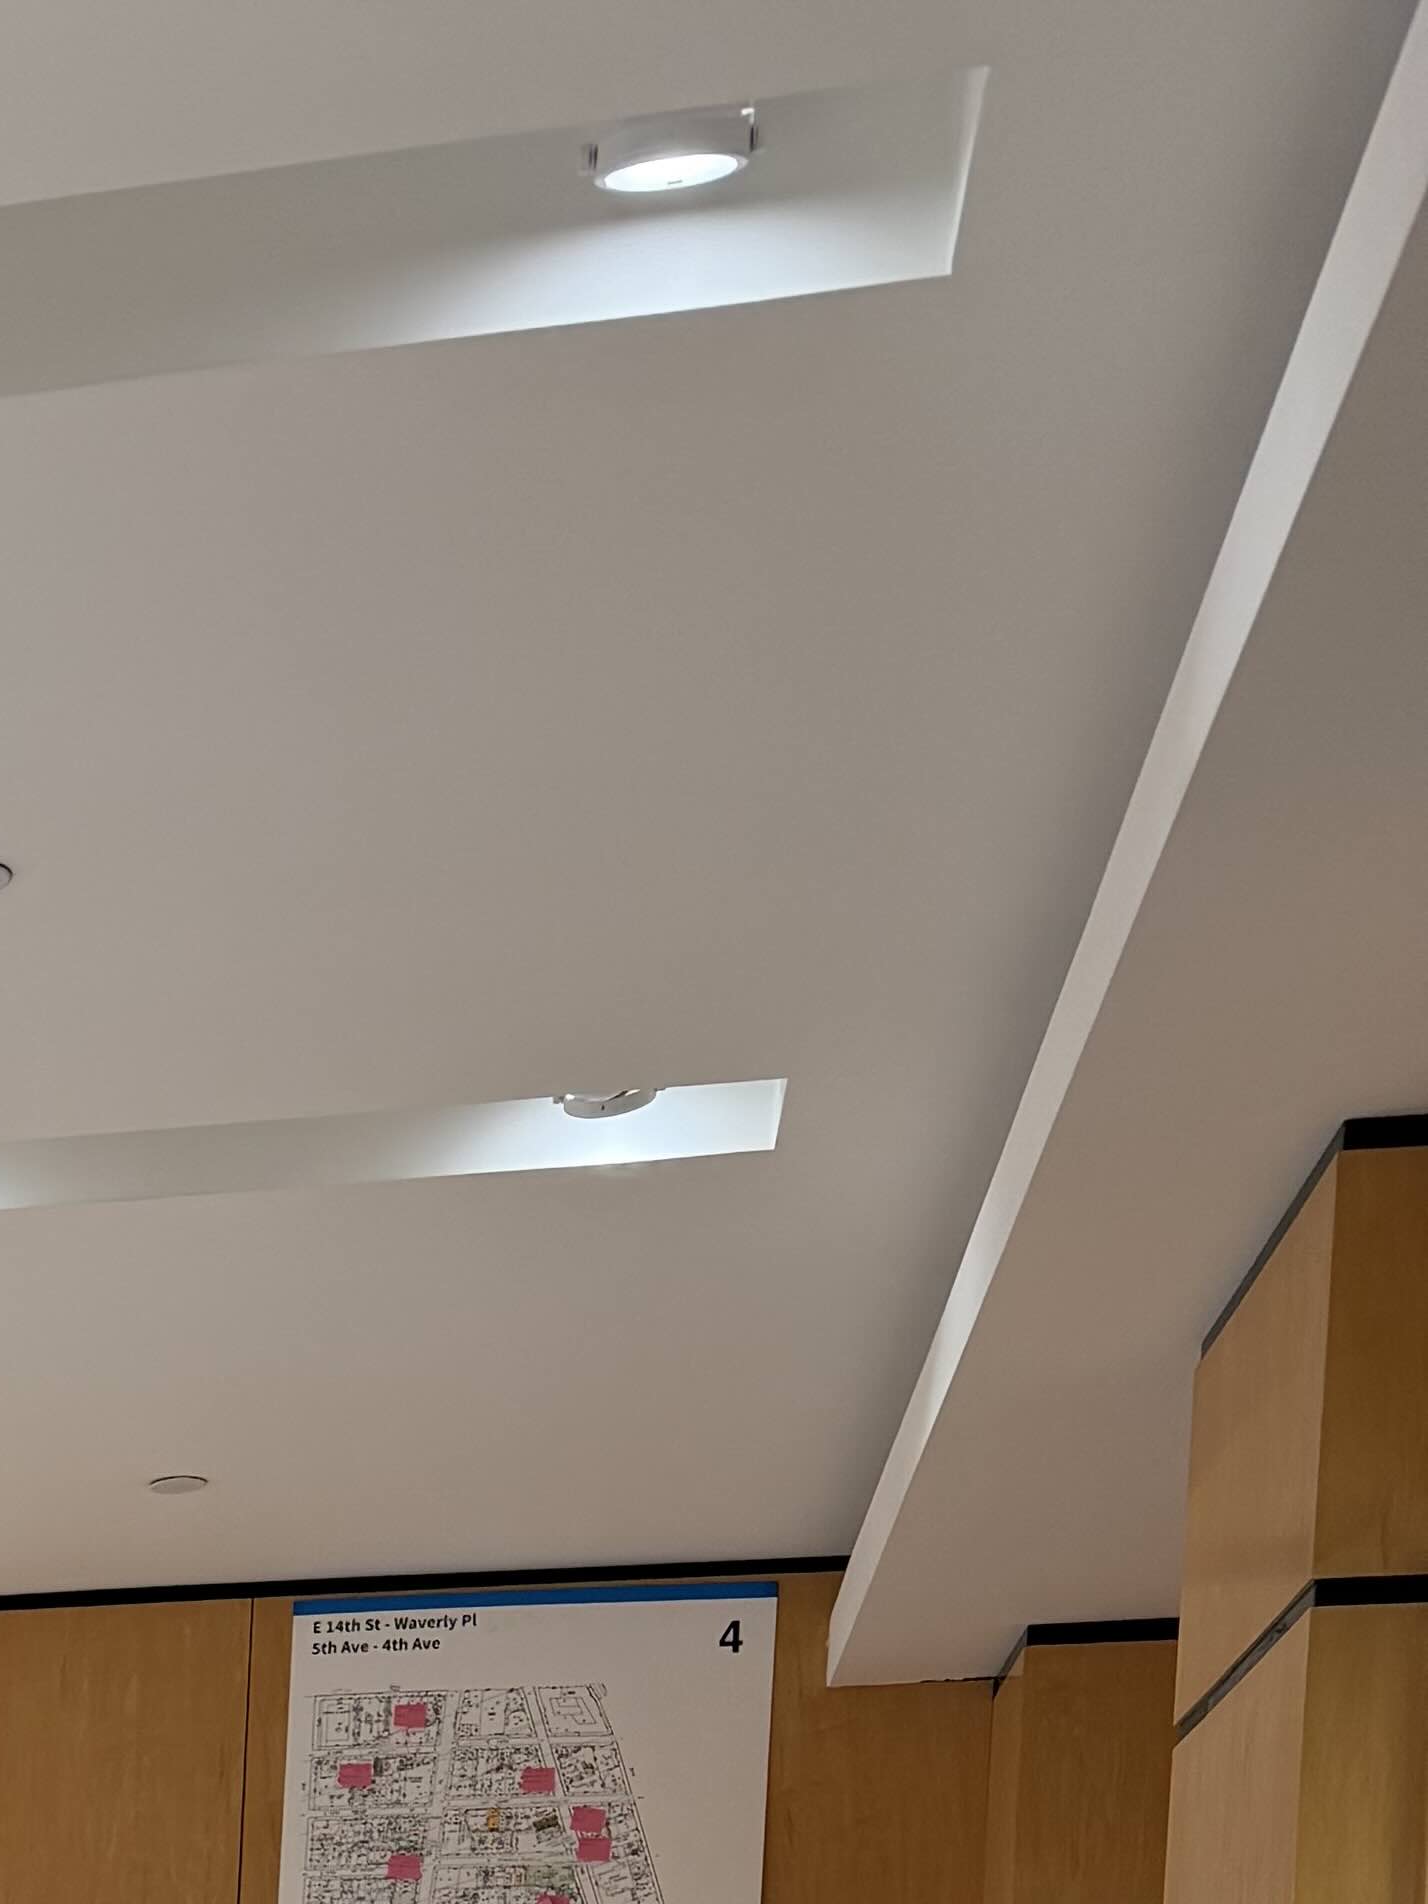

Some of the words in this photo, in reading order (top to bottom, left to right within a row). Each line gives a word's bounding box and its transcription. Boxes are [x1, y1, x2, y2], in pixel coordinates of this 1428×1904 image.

[313, 1621, 321, 1634] E
[326, 1618, 361, 1633] 14th
[365, 1617, 380, 1632] St
[394, 1614, 458, 1633] Waverly
[462, 1614, 478, 1629] Pl
[312, 1641, 339, 1656] 5th
[341, 1641, 370, 1655] Ave
[382, 1638, 409, 1653] 4th
[412, 1637, 441, 1651] Ave
[719, 1620, 743, 1653] 4
